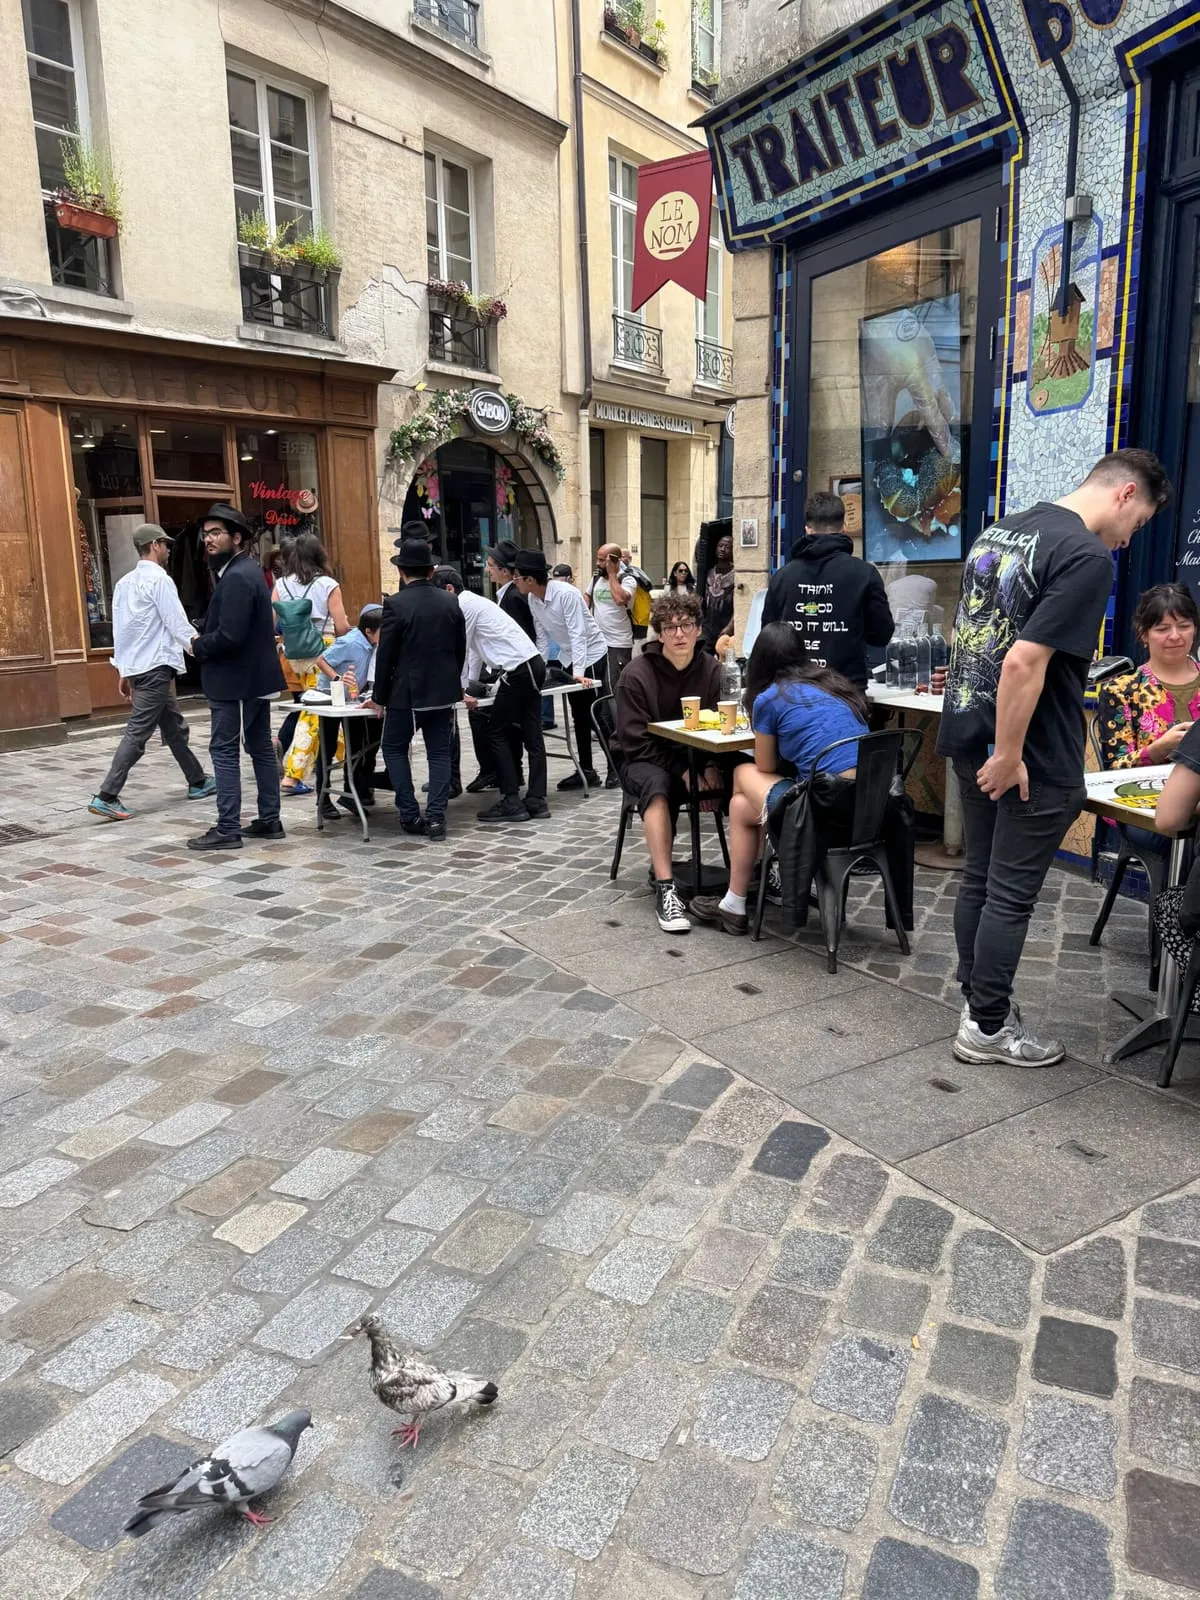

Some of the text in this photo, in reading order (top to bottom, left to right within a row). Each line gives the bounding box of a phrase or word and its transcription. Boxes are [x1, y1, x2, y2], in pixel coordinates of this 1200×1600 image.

[728, 22, 984, 205] TRAITEUR
[660, 199, 683, 221] LE
[649, 221, 692, 249] NOM
[477, 400, 505, 421] SABON
[596, 402, 695, 434] MONKEY BUSINESS GALLERY
[248, 480, 309, 506] Vintage
[798, 583, 834, 595] THINK
[807, 621, 819, 632] IT
[822, 621, 849, 632] WILL
[804, 640, 820, 650] BE
